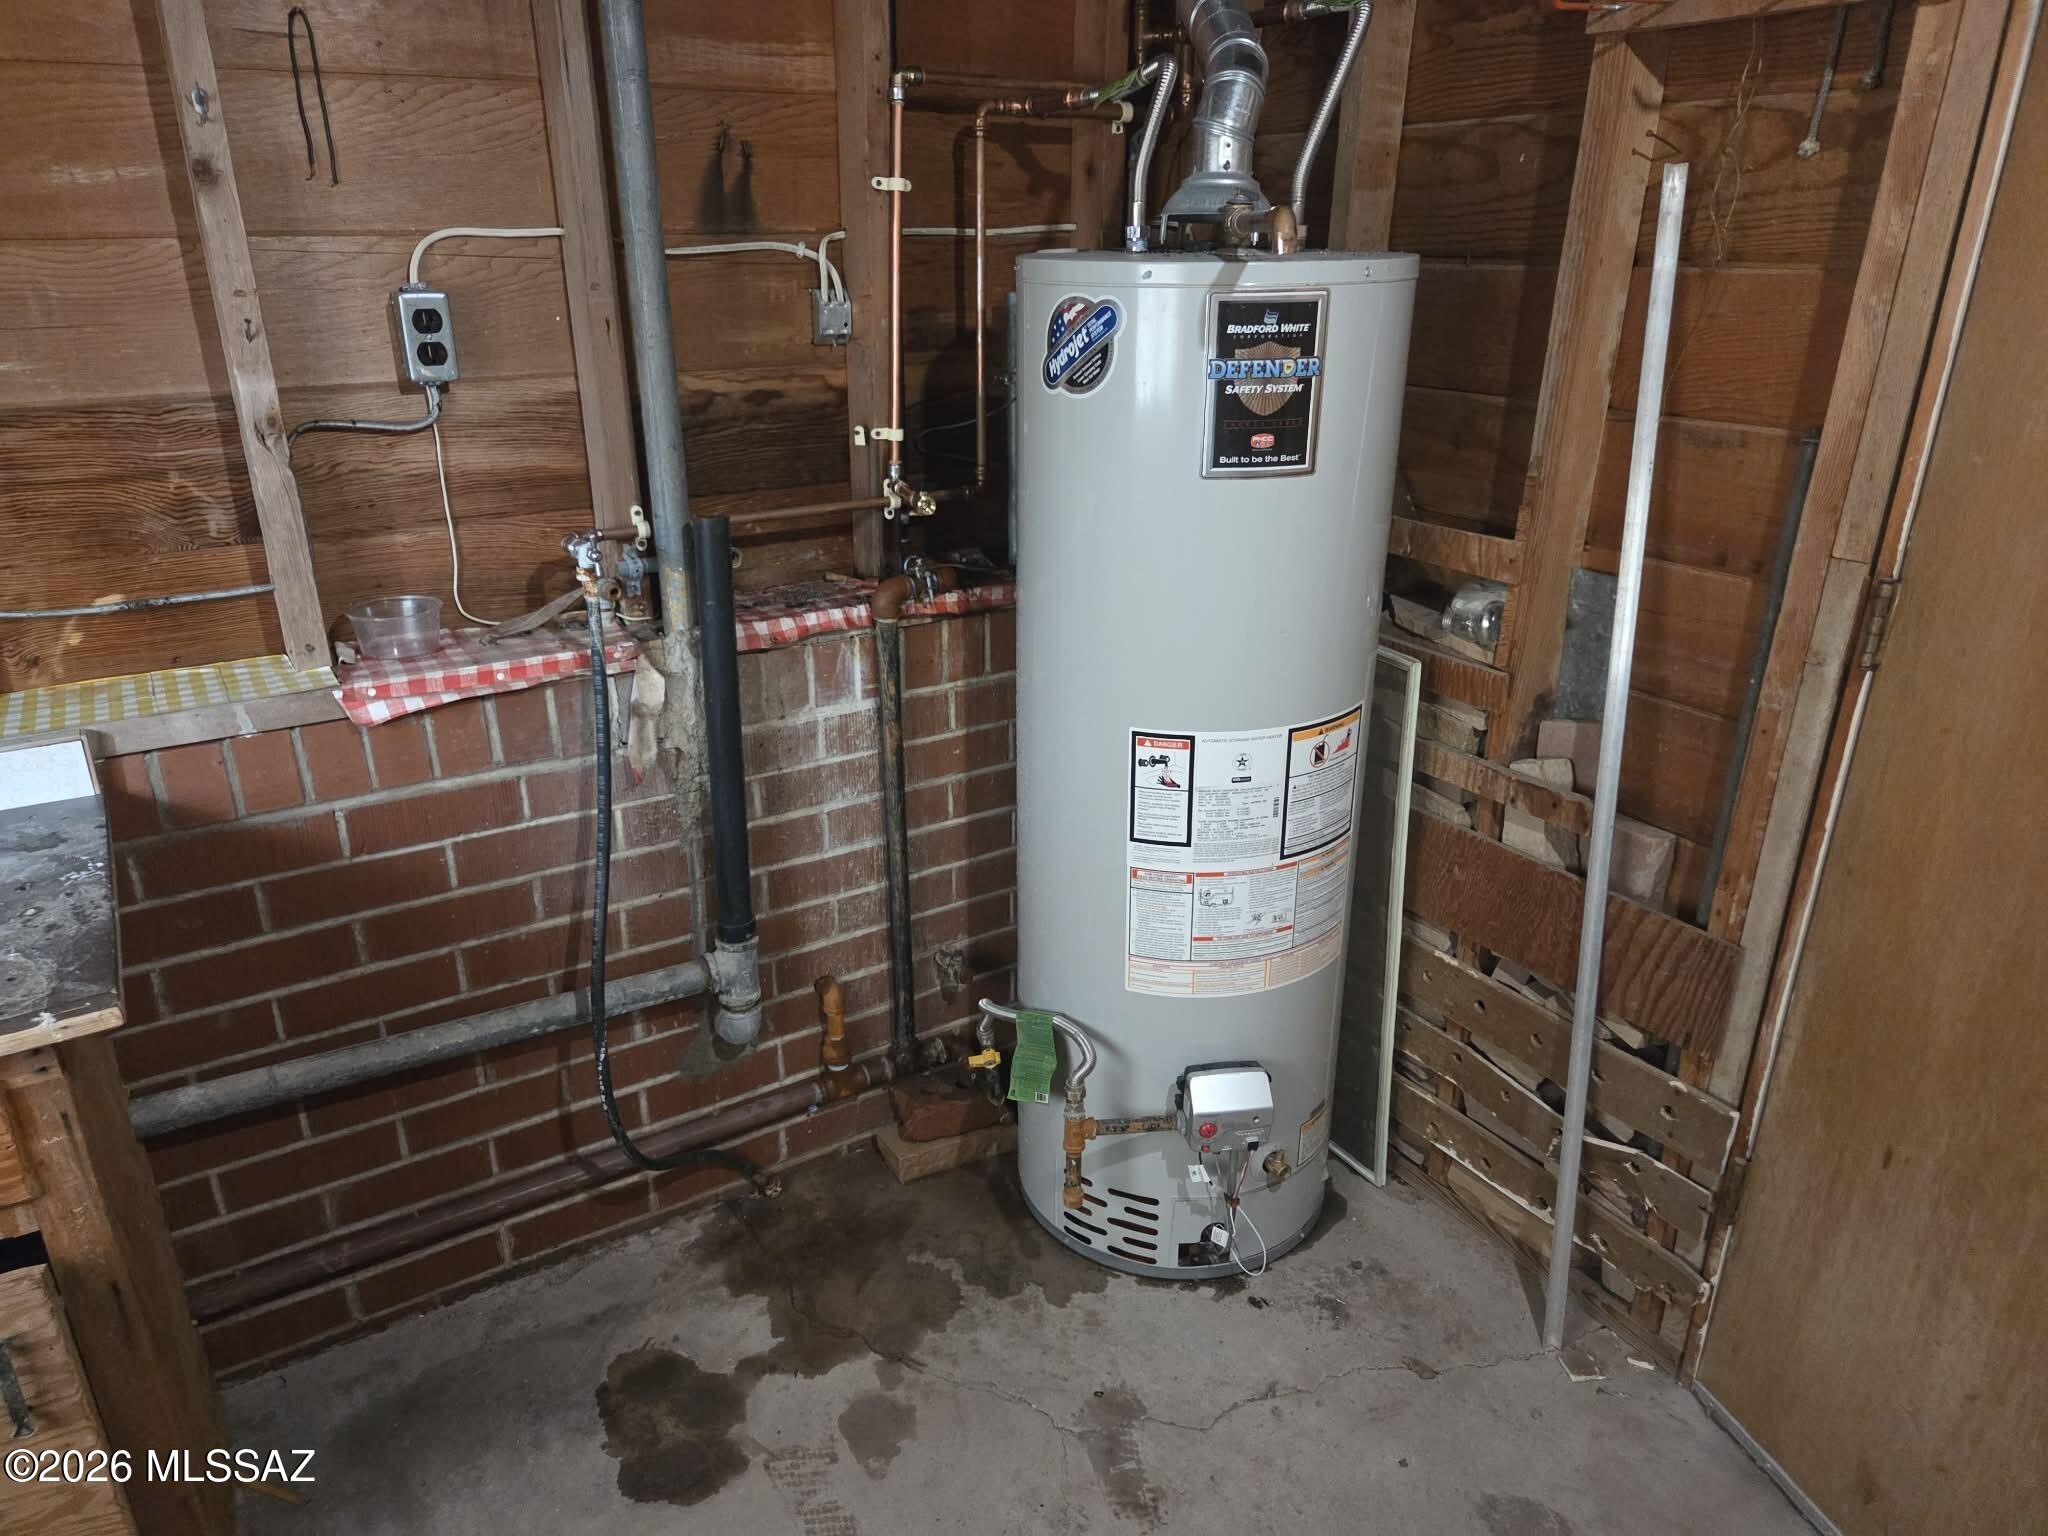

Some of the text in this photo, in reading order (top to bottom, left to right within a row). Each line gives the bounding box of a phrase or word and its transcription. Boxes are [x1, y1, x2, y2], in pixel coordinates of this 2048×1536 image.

[1226, 323, 1311, 334] BRADFORD WHITE
[1208, 357, 1320, 379] DEFENDER
[1225, 383, 1303, 394] SAFETY SYSTEM
[1219, 456, 1239, 464] Built
[1251, 455, 1263, 463] be
[1280, 454, 1299, 462] Best
[1153, 740, 1183, 749] DANGER
